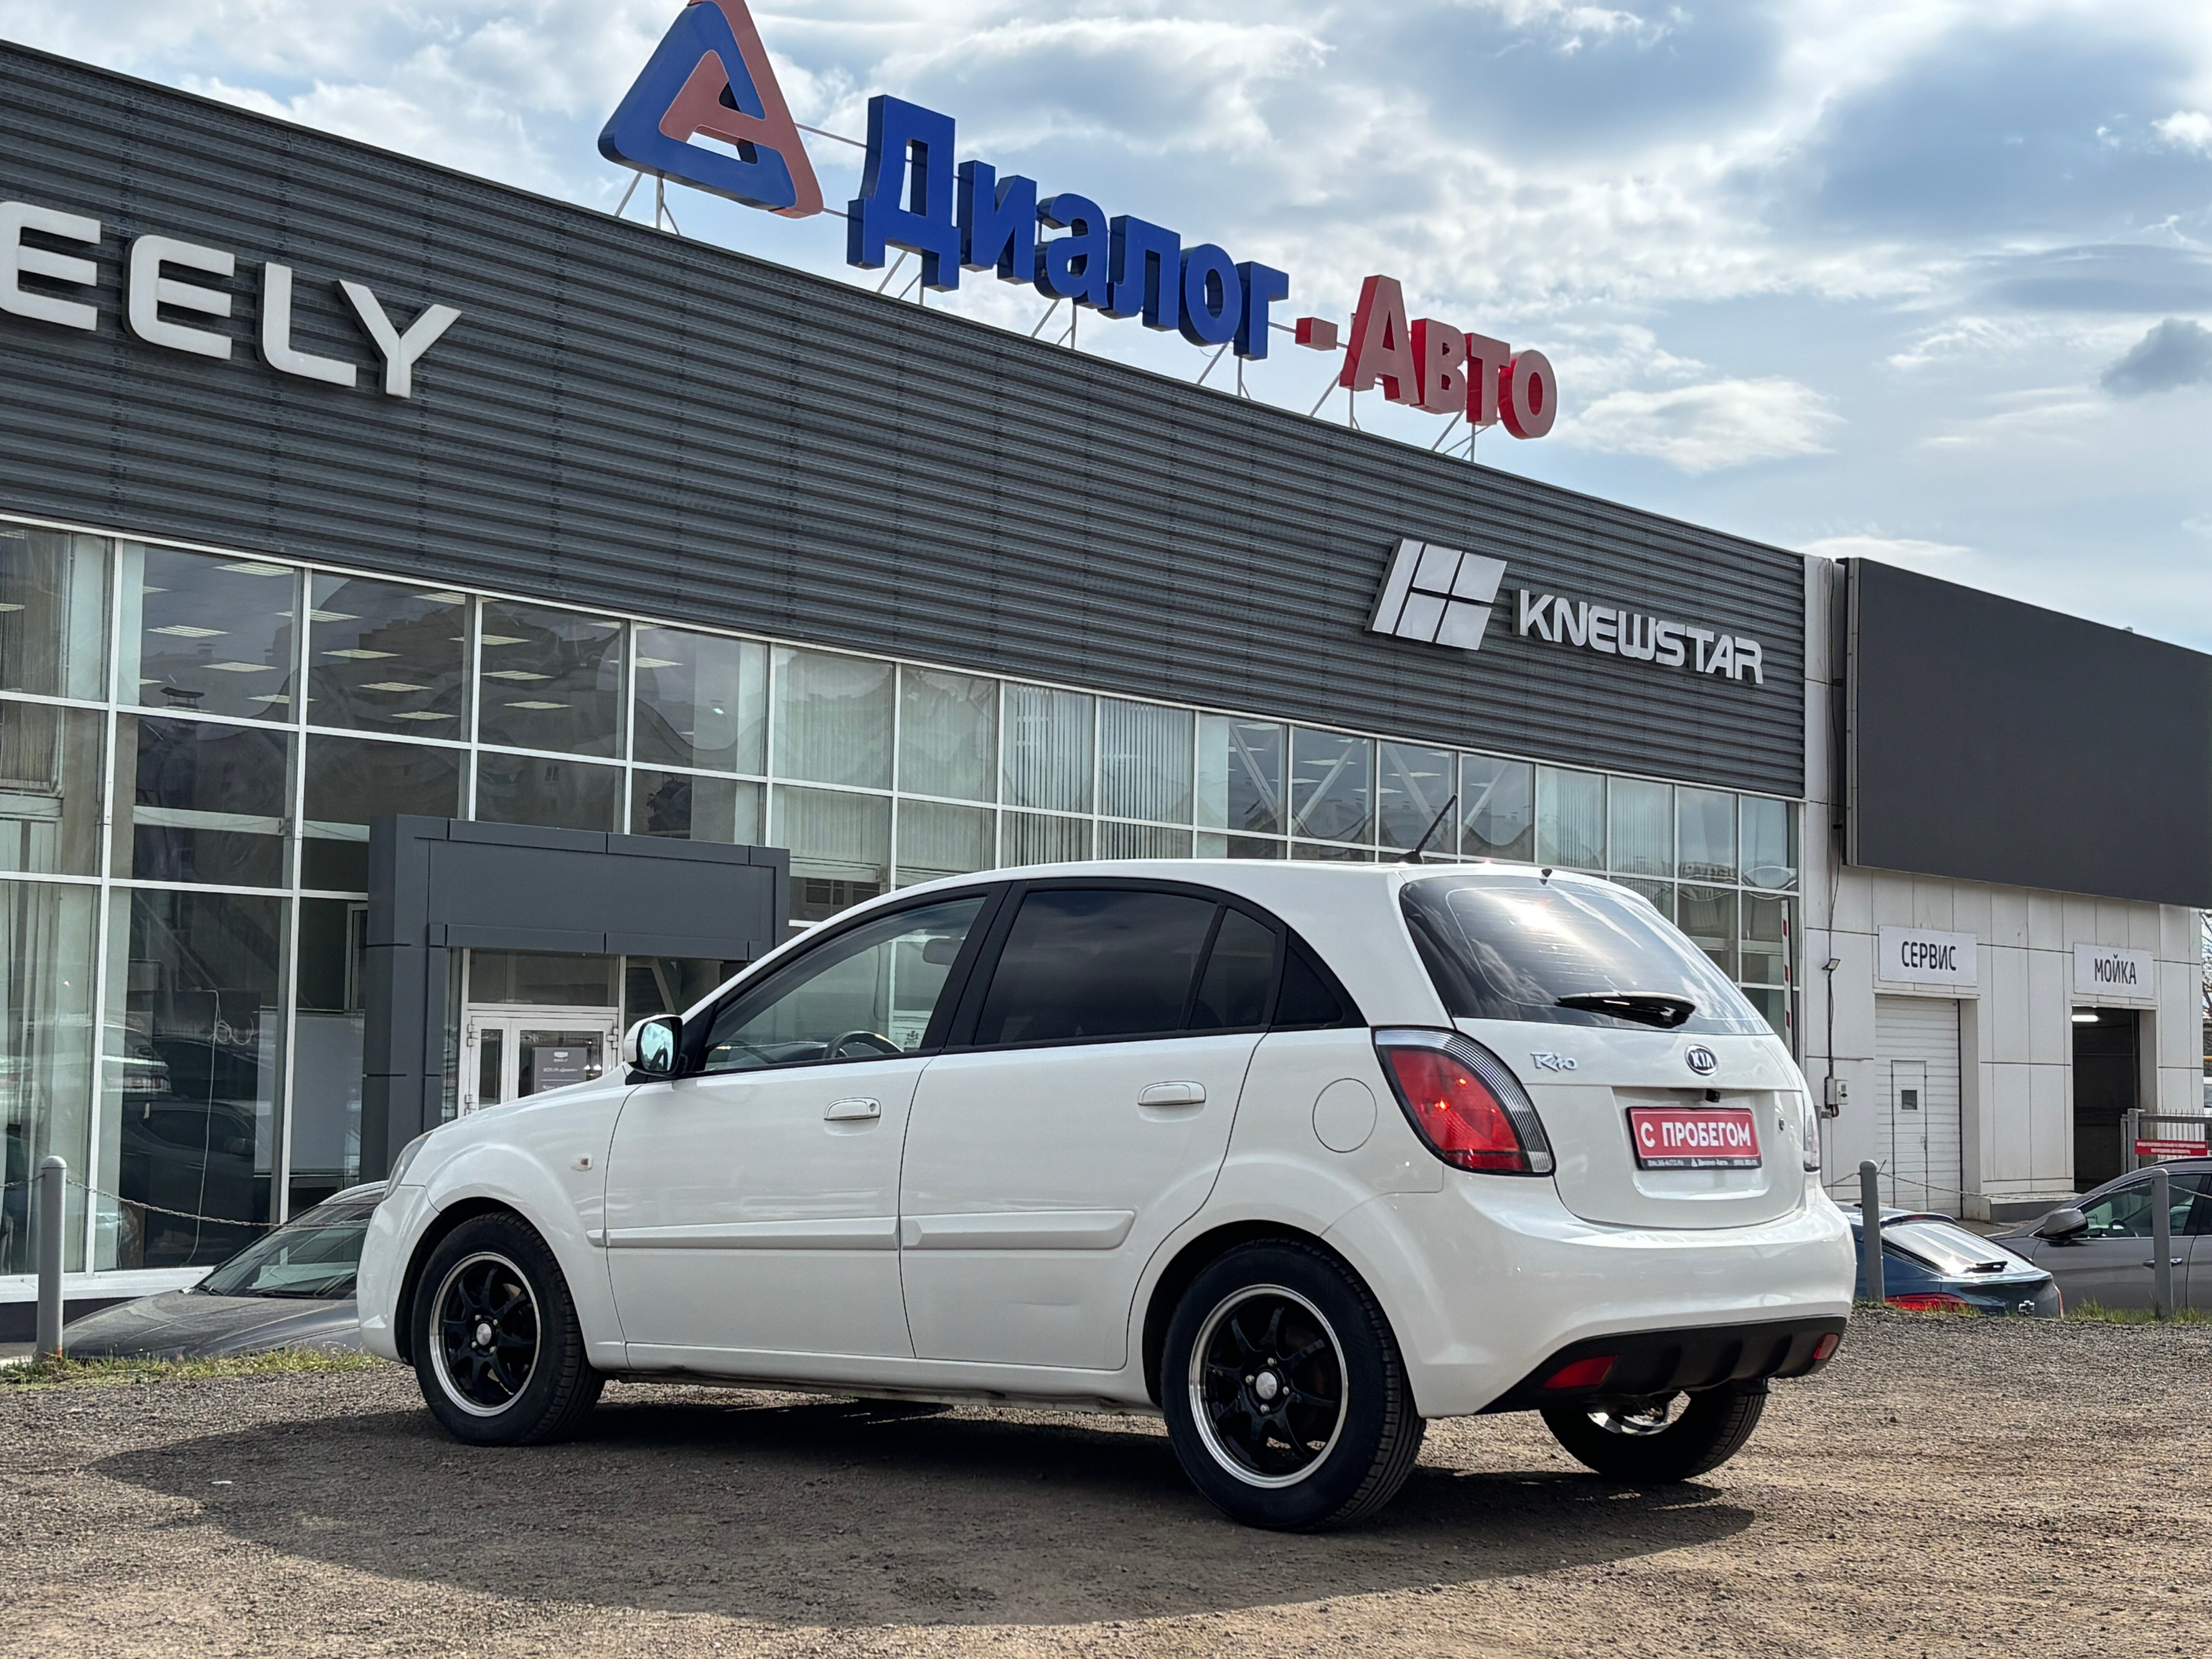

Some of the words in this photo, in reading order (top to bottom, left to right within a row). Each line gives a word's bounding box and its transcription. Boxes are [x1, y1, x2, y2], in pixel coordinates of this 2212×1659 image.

[847, 94, 1557, 440] Диалог-Авто
[0, 201, 462, 399] EELY
[1518, 589, 1763, 684] KNEWSTAR
[1901, 941, 1956, 971] СЕРВИС
[2094, 954, 2137, 985] МОЙКА
[1690, 1051, 1714, 1068] KIA
[1640, 1121, 1656, 1148] С
[1662, 1121, 1752, 1147] ПРОБЕГОМ
